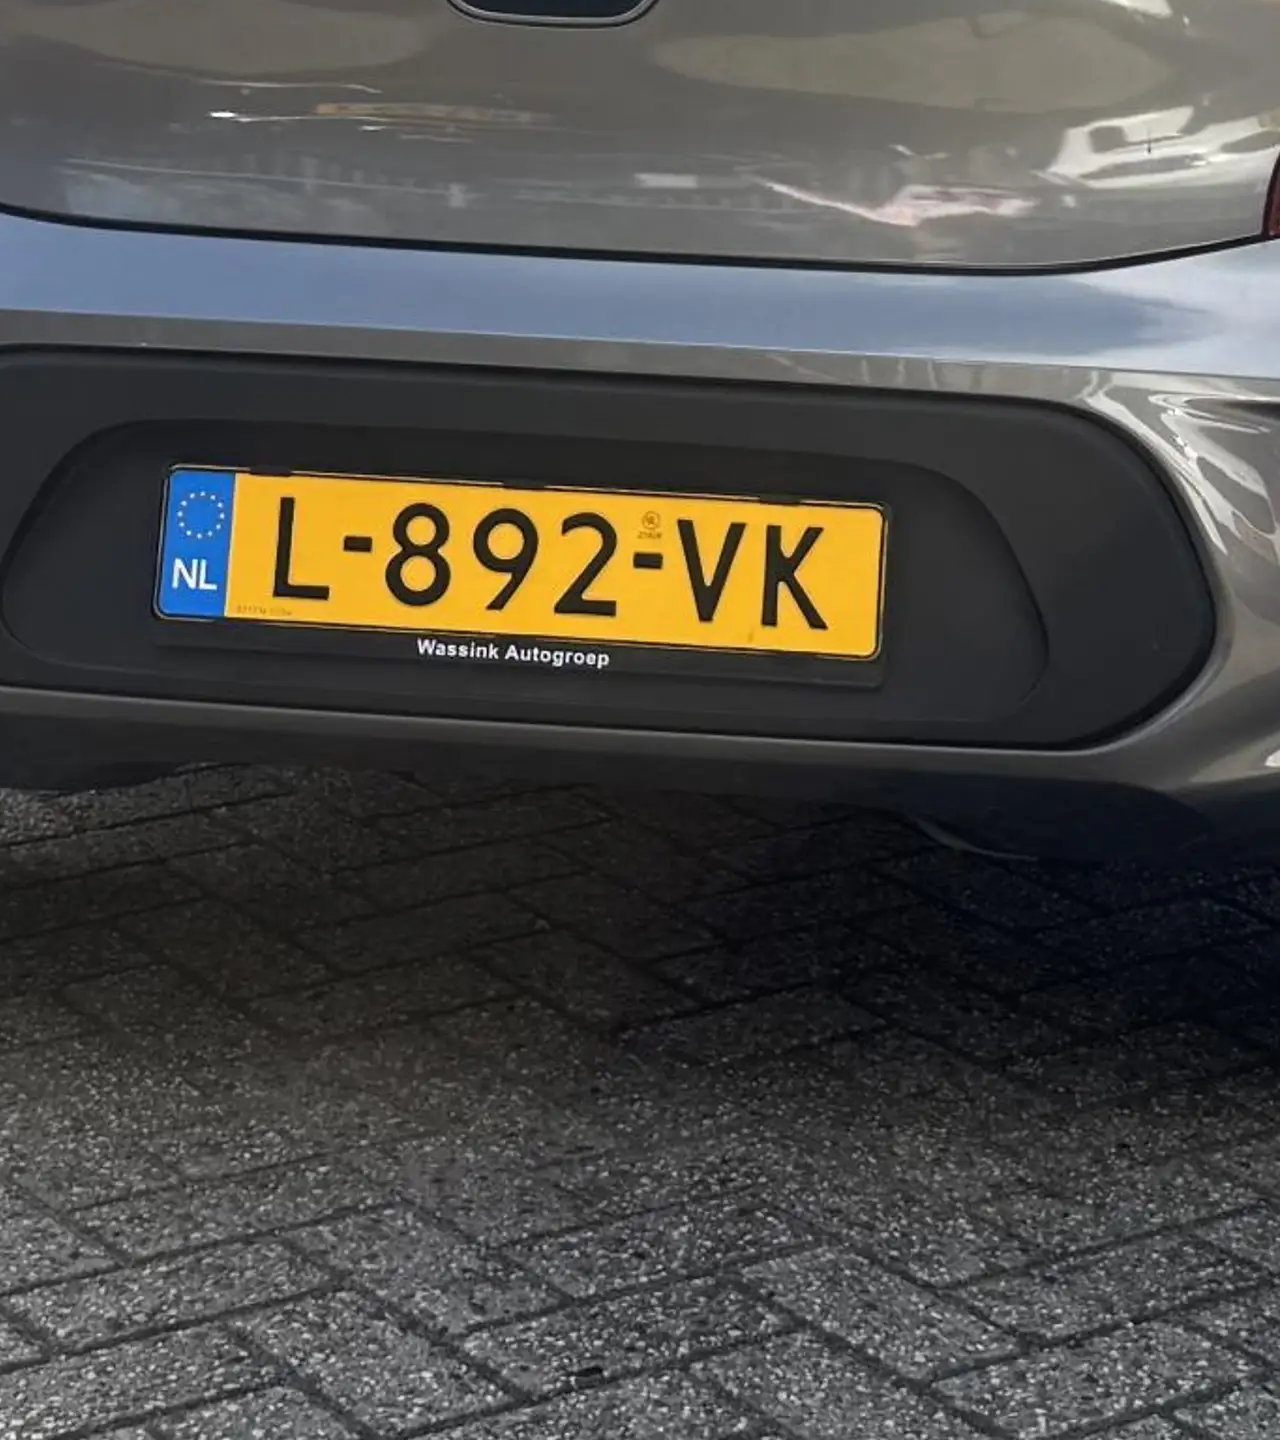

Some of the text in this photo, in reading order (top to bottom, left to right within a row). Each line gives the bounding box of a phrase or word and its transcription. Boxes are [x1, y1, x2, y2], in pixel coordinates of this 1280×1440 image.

[171, 557, 218, 590] NL
[271, 496, 829, 631] L-892-VK
[416, 637, 610, 669] Wassink Autogroep
